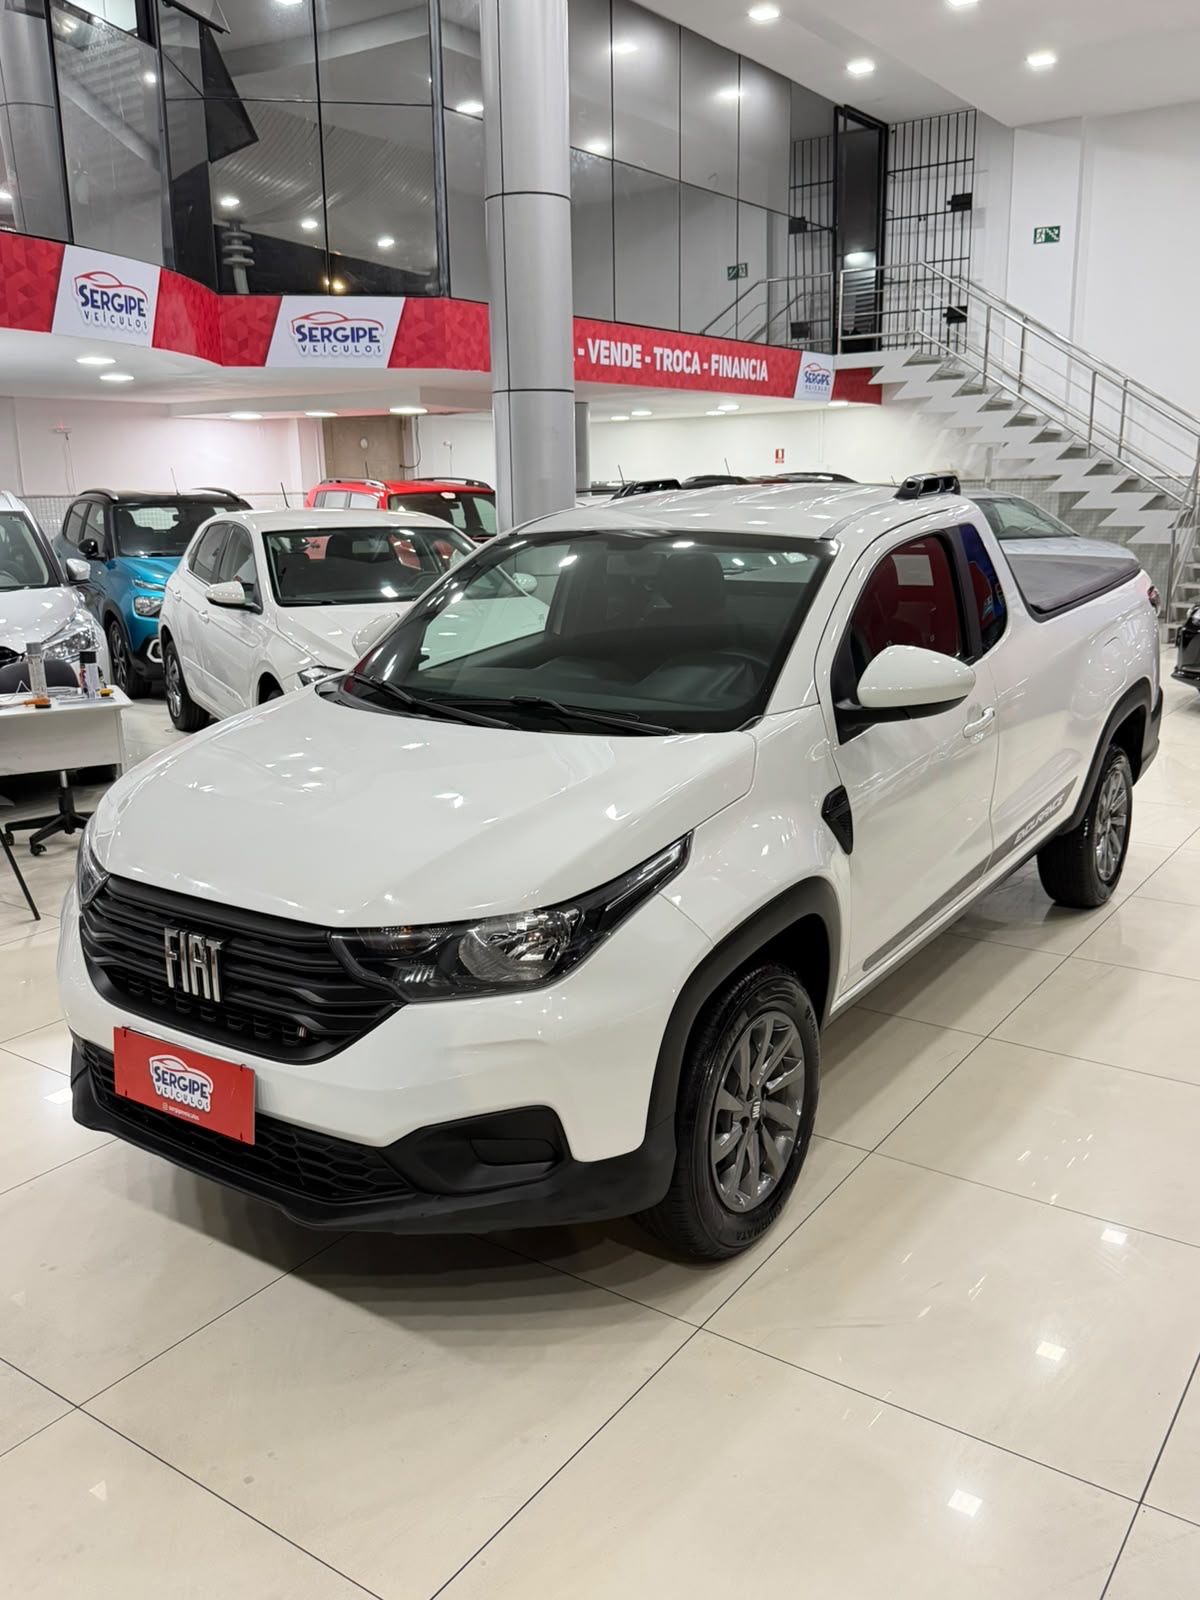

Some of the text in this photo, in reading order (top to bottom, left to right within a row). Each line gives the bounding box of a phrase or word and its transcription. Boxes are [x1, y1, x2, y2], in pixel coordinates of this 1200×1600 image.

[79, 284, 146, 318] SERGIPE
[295, 324, 381, 343] SERGIPE
[300, 343, 382, 353] VEÍCULOS
[587, 338, 642, 369] VENDE
[653, 346, 701, 375] TROCA
[711, 354, 769, 382] FINANCIA
[164, 927, 223, 1003] FIAT
[154, 1065, 209, 1100] SERGIPE
